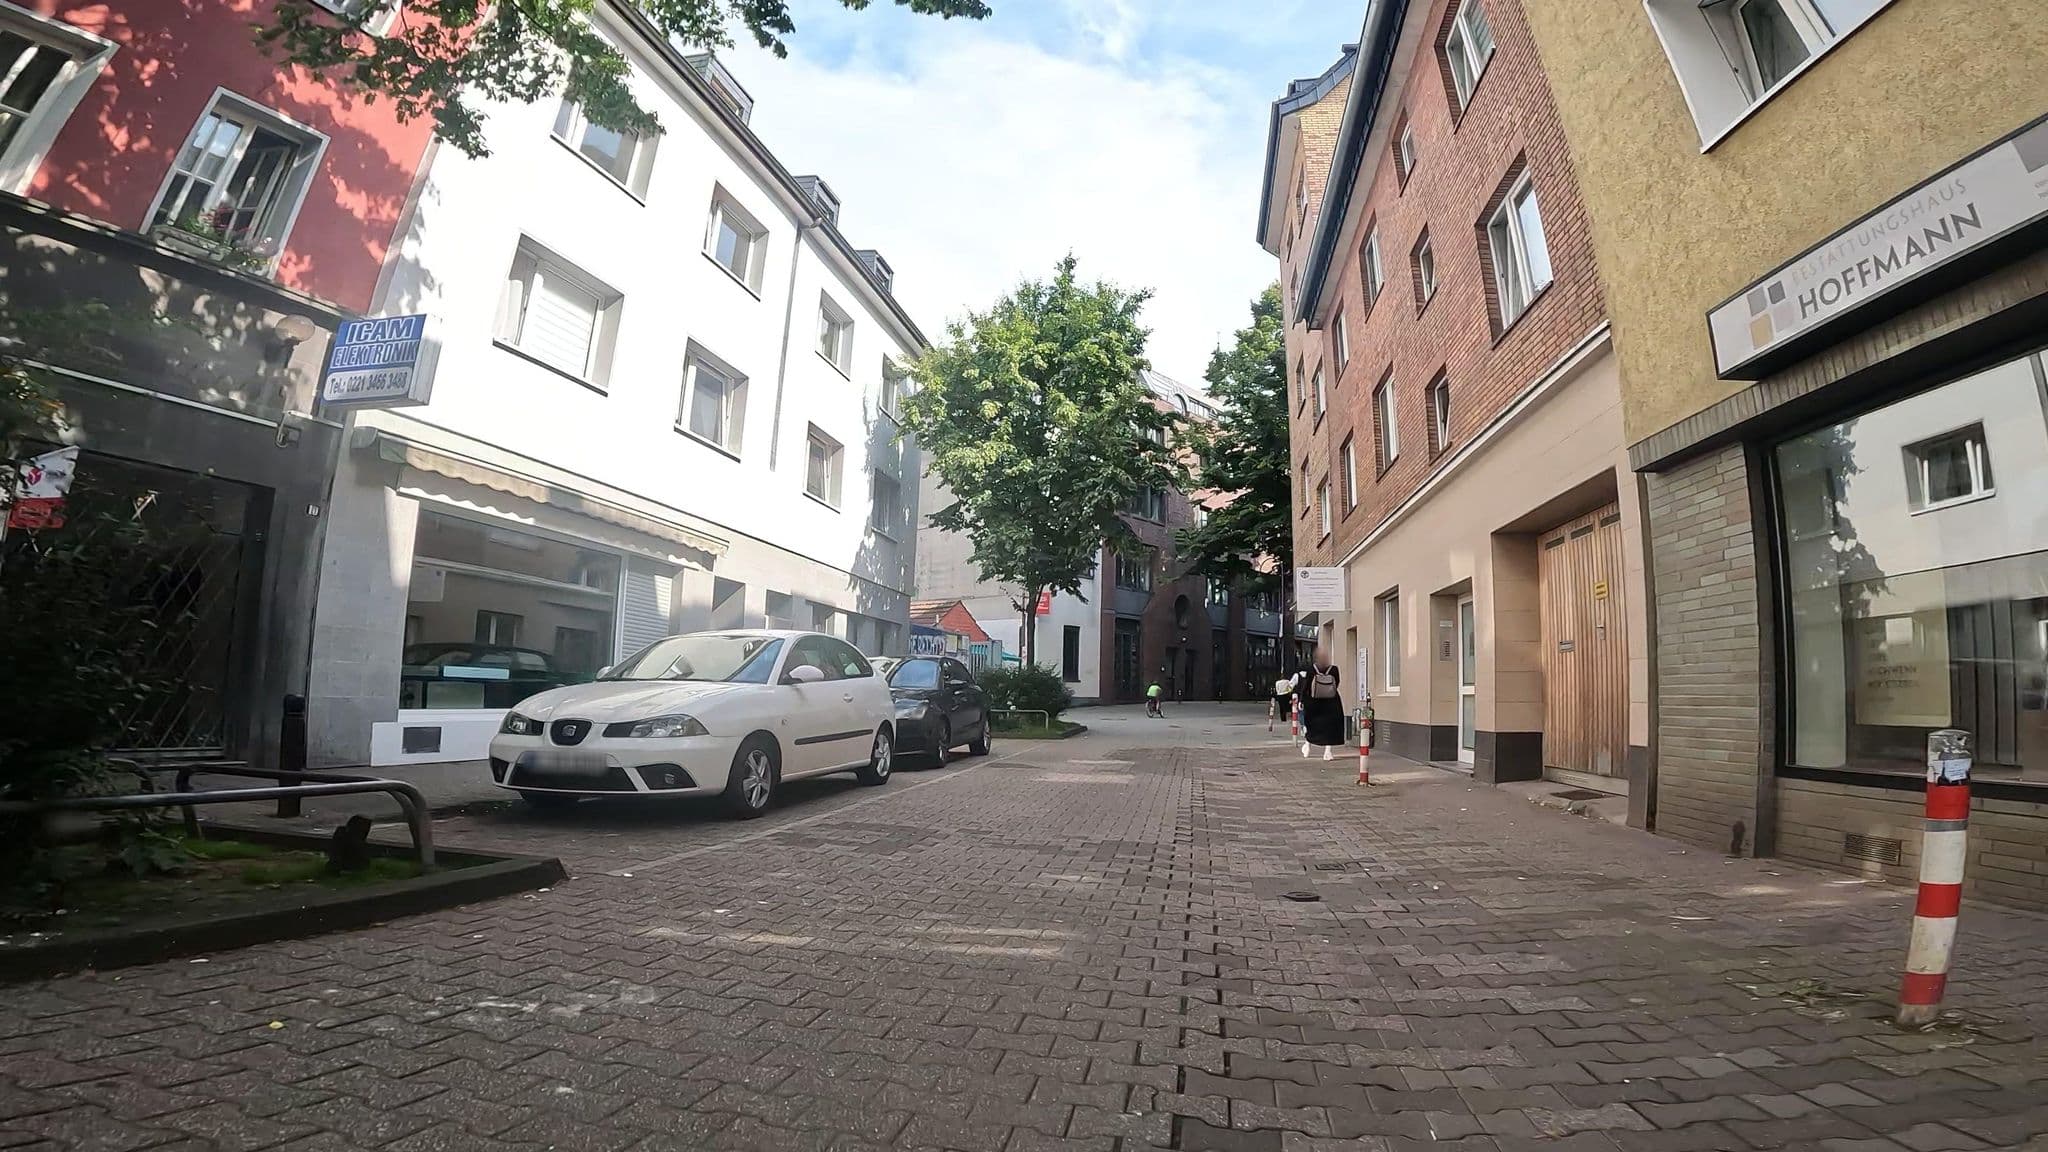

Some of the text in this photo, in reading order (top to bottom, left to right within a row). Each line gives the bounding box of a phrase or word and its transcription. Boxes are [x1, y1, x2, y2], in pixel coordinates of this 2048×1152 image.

[1798, 202, 1982, 319] HOFFMANN
[345, 317, 416, 344] ICAM
[330, 339, 419, 368] ELEKTRONIK
[346, 375, 365, 392] 0221
